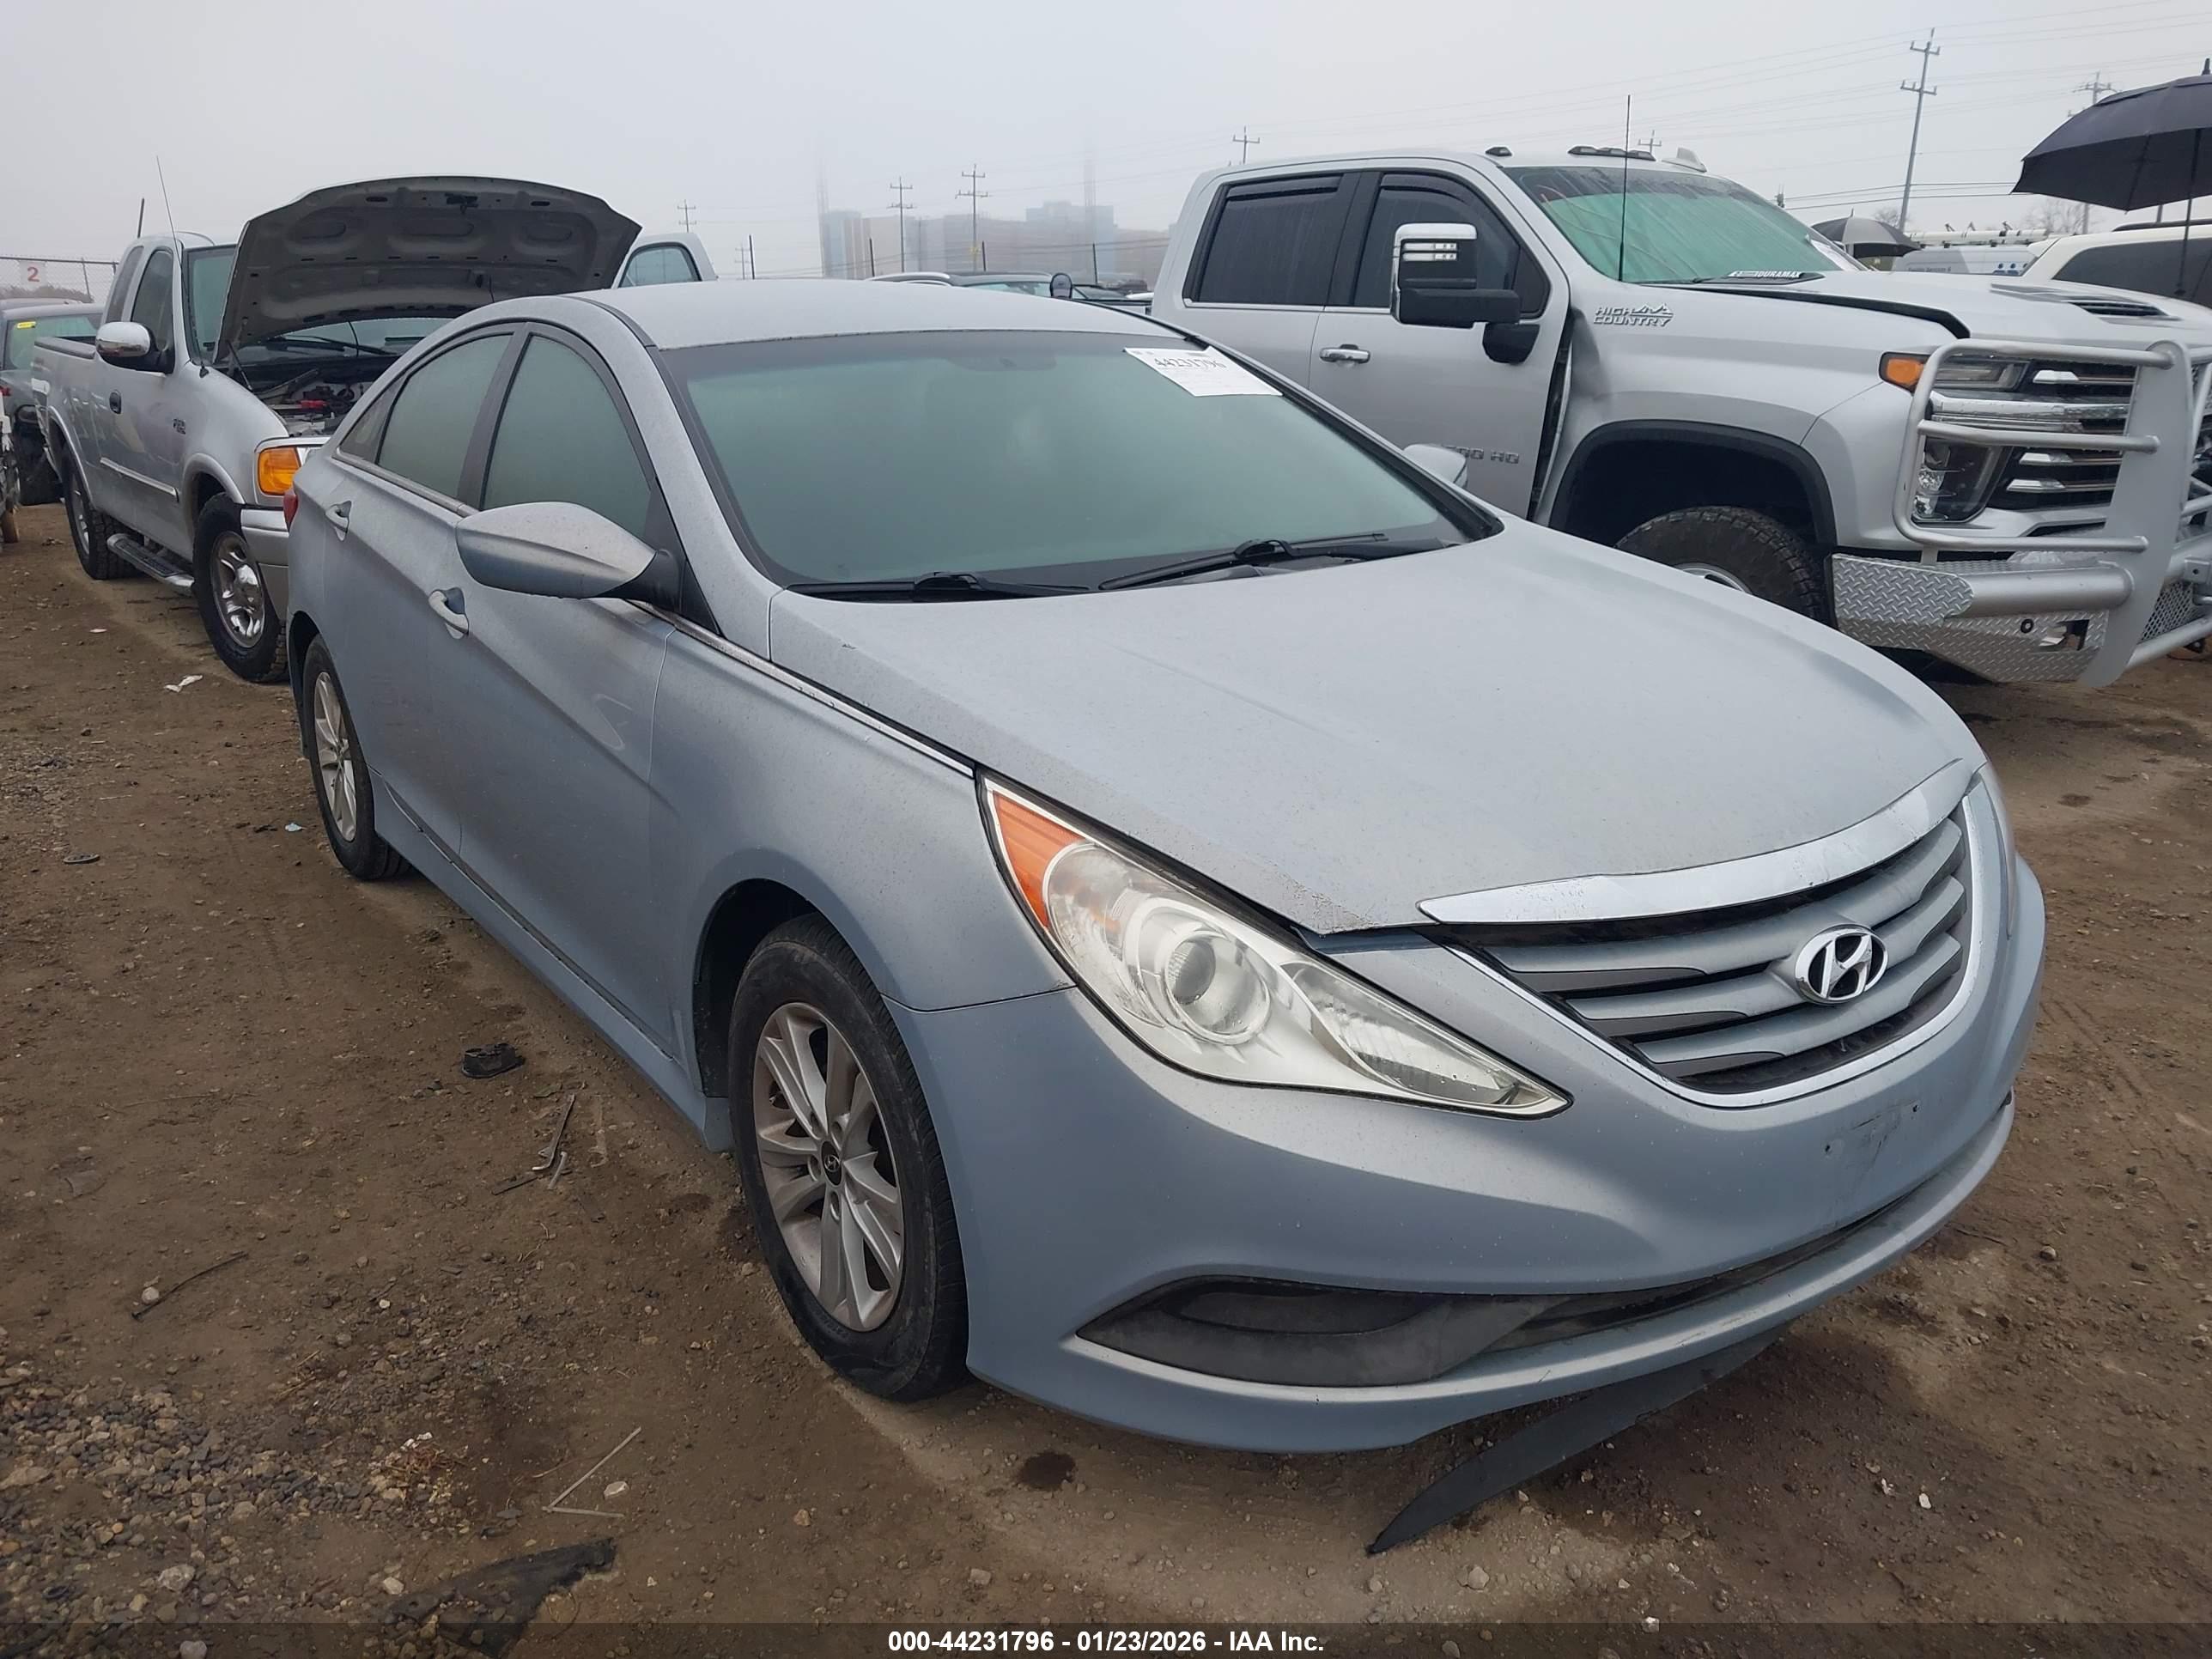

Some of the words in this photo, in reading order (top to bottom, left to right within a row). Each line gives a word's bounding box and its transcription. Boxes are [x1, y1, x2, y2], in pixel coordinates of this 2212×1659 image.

[27, 266, 40, 283] 2
[1595, 307, 1635, 316] HIGH
[1594, 315, 1671, 327] COUNTRY
[1491, 451, 1519, 464] HD
